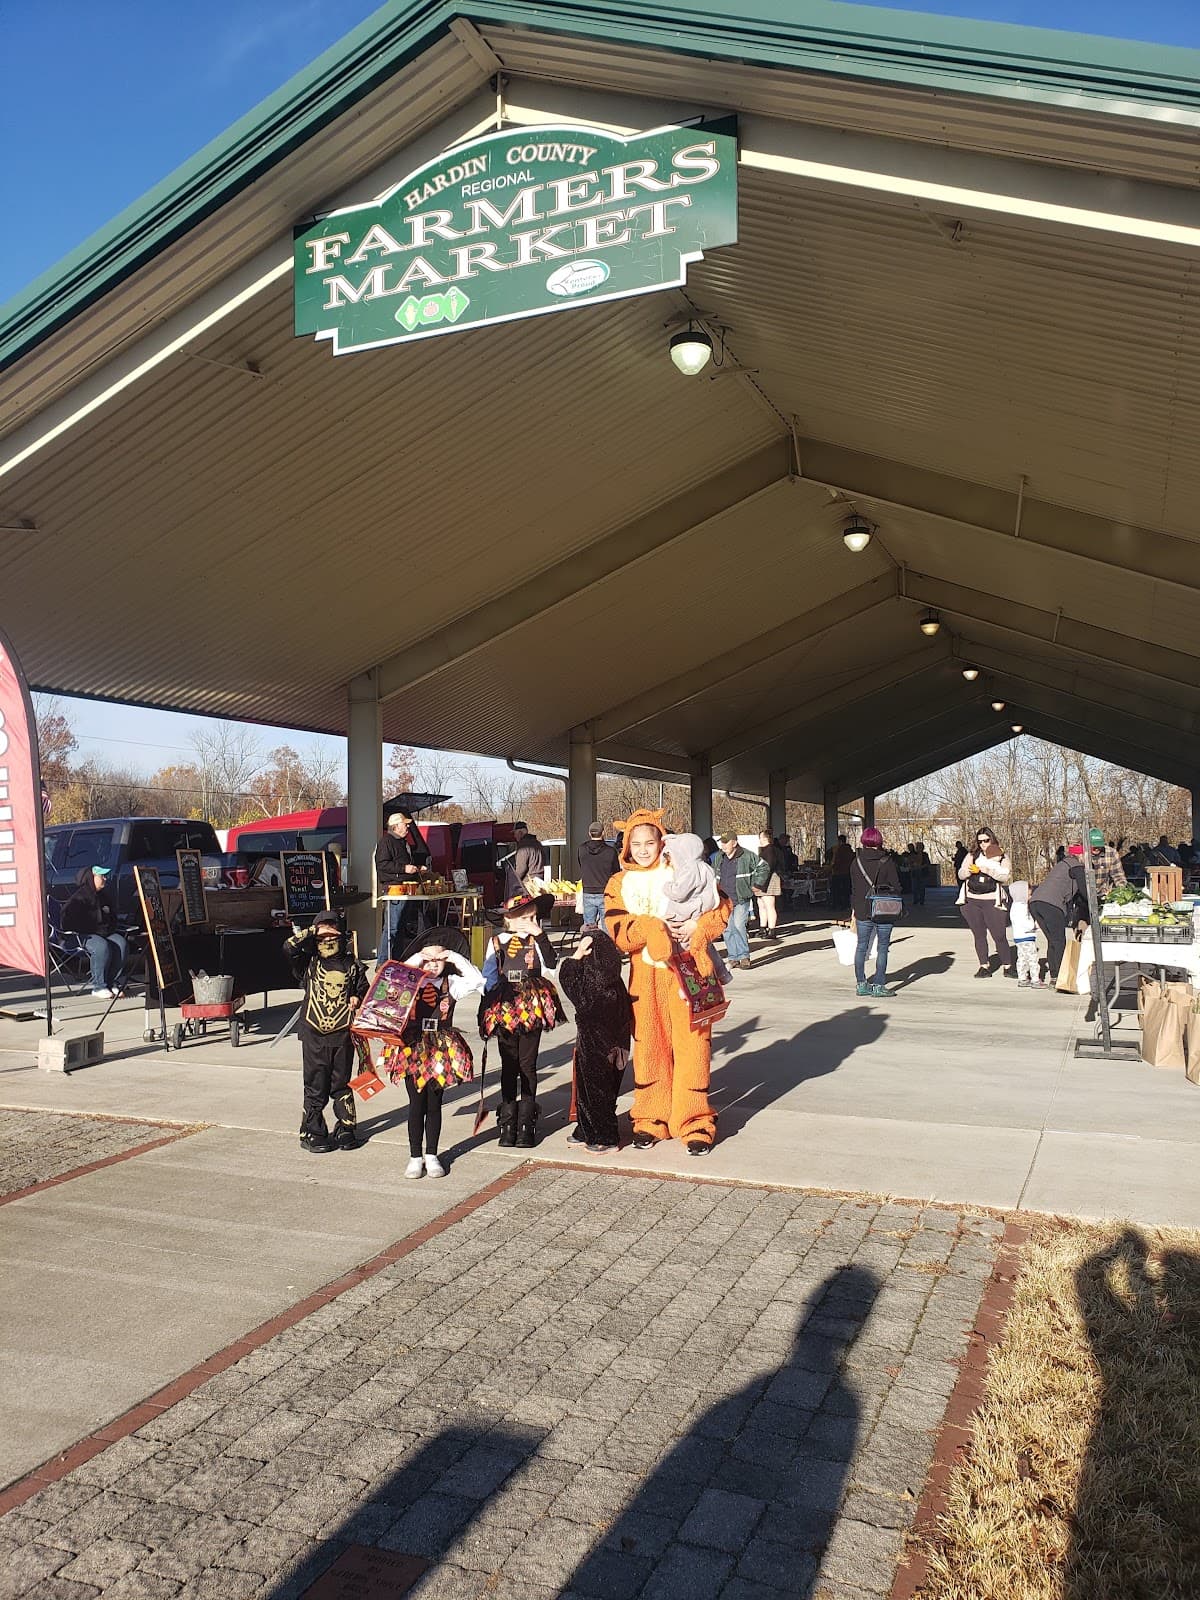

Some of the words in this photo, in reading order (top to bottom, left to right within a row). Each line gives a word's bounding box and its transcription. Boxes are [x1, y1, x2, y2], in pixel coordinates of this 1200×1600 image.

[305, 141, 720, 274] FARMERS
[404, 154, 487, 211] HARDIN
[506, 143, 597, 166] COUNTY
[461, 169, 535, 198] REGIONAL
[322, 195, 692, 310] MARKET
